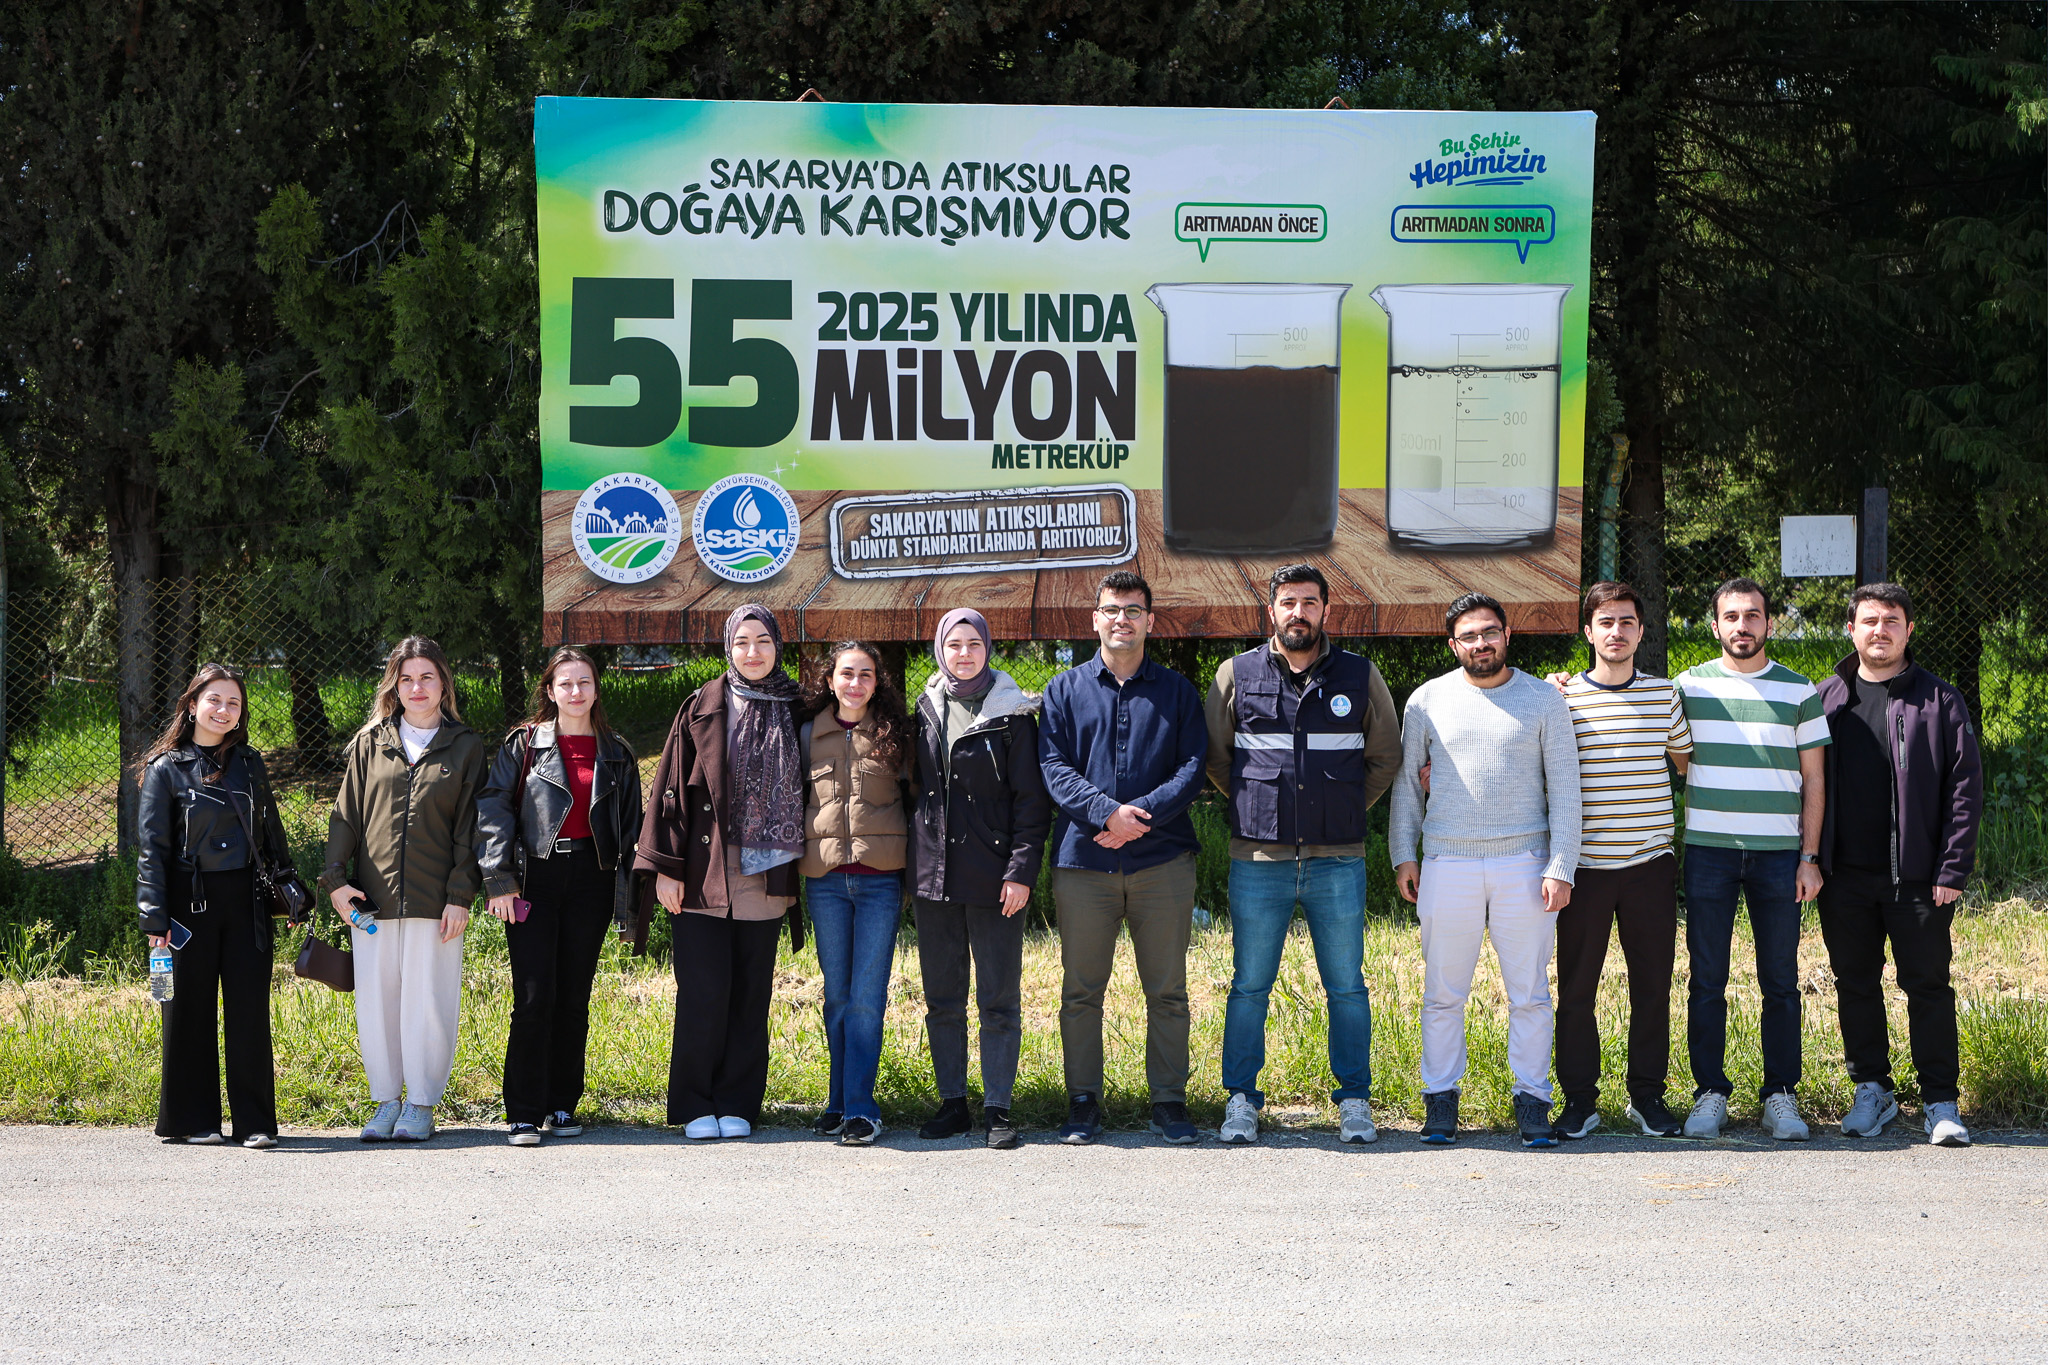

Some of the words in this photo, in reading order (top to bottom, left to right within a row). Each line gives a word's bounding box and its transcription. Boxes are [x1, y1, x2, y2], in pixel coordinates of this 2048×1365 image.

[1439, 138, 1466, 156] Bu
[1468, 131, 1521, 156] Şehir
[710, 158, 931, 193] SAKARYA'DA
[941, 161, 1131, 194] ATIKSULAR
[1409, 148, 1547, 189] Hepimizin
[604, 183, 806, 240] DOĞAYA
[820, 193, 1131, 246] KARIŞMIYOR
[1183, 215, 1273, 233] ARITMADAN
[1277, 213, 1319, 233] ÖNCE
[1401, 216, 1490, 233] ARITMADAN
[1493, 216, 1546, 233] SONRA
[817, 291, 939, 342] 2025
[949, 292, 1138, 343] YILINDA
[1283, 327, 1308, 342] 500
[1505, 327, 1530, 342] 500
[569, 277, 800, 448] 55
[1503, 411, 1527, 426] 300
[991, 437, 1130, 470] METREKÜP
[1502, 453, 1526, 467] 200
[594, 476, 659, 494] SAKARYA
[1502, 494, 1525, 508] 100
[694, 490, 716, 528] SAKARYA
[715, 476, 769, 492] BÜYÜKŞEHİR
[869, 508, 980, 538] SAKARYA'NIN
[986, 501, 1101, 529] ATIKSULARINI
[695, 533, 704, 545] SU
[700, 547, 710, 559] VE
[709, 558, 776, 580] KANALİZASYON
[850, 535, 898, 561] DÜNYA
[903, 529, 1037, 558] STANDARTLARINDA
[1041, 526, 1122, 549] ARITIYORUZ
